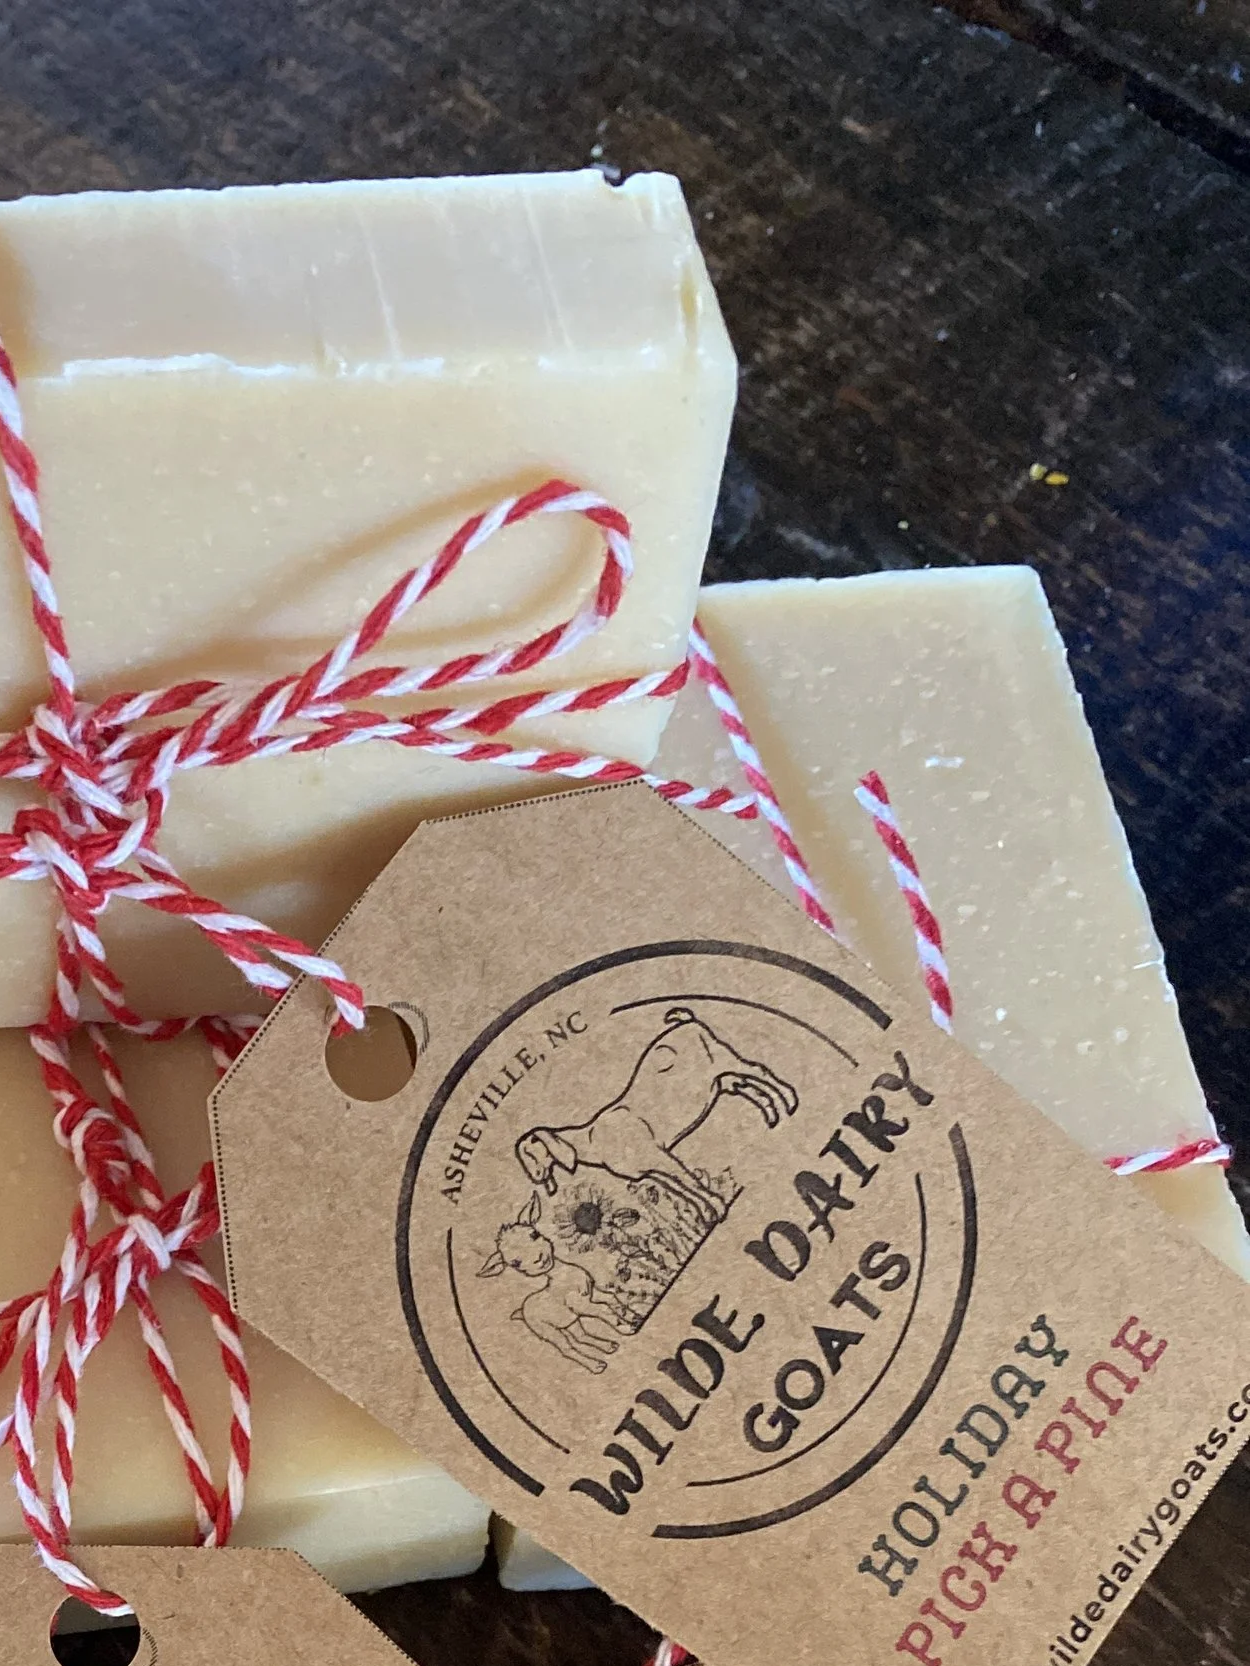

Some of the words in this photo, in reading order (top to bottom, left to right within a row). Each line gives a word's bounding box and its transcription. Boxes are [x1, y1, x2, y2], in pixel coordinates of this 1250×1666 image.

[440, 1047, 545, 1205] ASHEVILLE,
[543, 1010, 588, 1049] NC
[570, 1295, 765, 1516] WILDE
[745, 1052, 935, 1283] DAIRY
[743, 1239, 912, 1453] GOATS
[858, 1313, 1072, 1598] HOLIDAY
[1002, 1475, 1058, 1531] A
[1037, 1317, 1169, 1476] PINE
